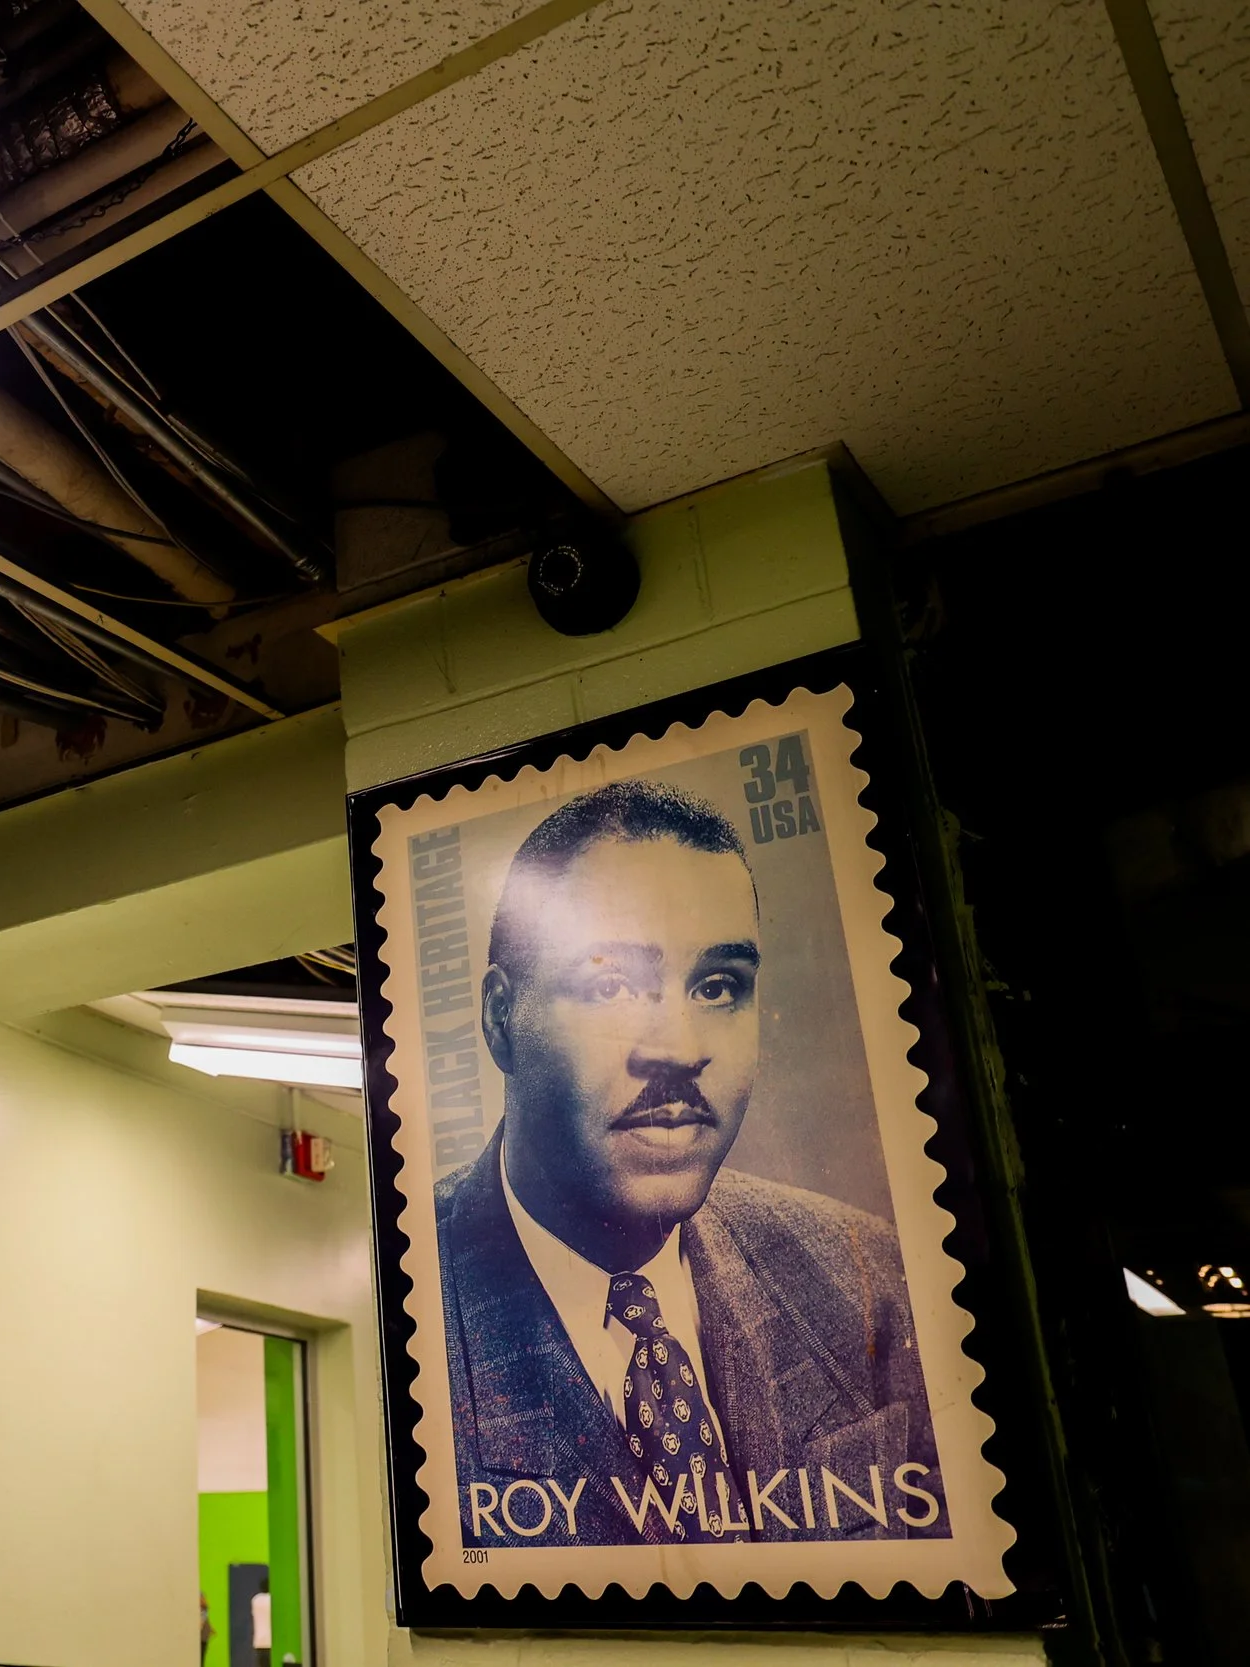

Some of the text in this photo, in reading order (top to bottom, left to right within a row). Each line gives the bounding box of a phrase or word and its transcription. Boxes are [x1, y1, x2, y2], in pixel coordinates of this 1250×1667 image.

[739, 734, 810, 804] 34
[749, 795, 821, 845] USA
[412, 826, 486, 1167] BLACK HERITAGE
[468, 1462, 939, 1538] ROY WILKINS
[462, 1550, 489, 1564] 2001
